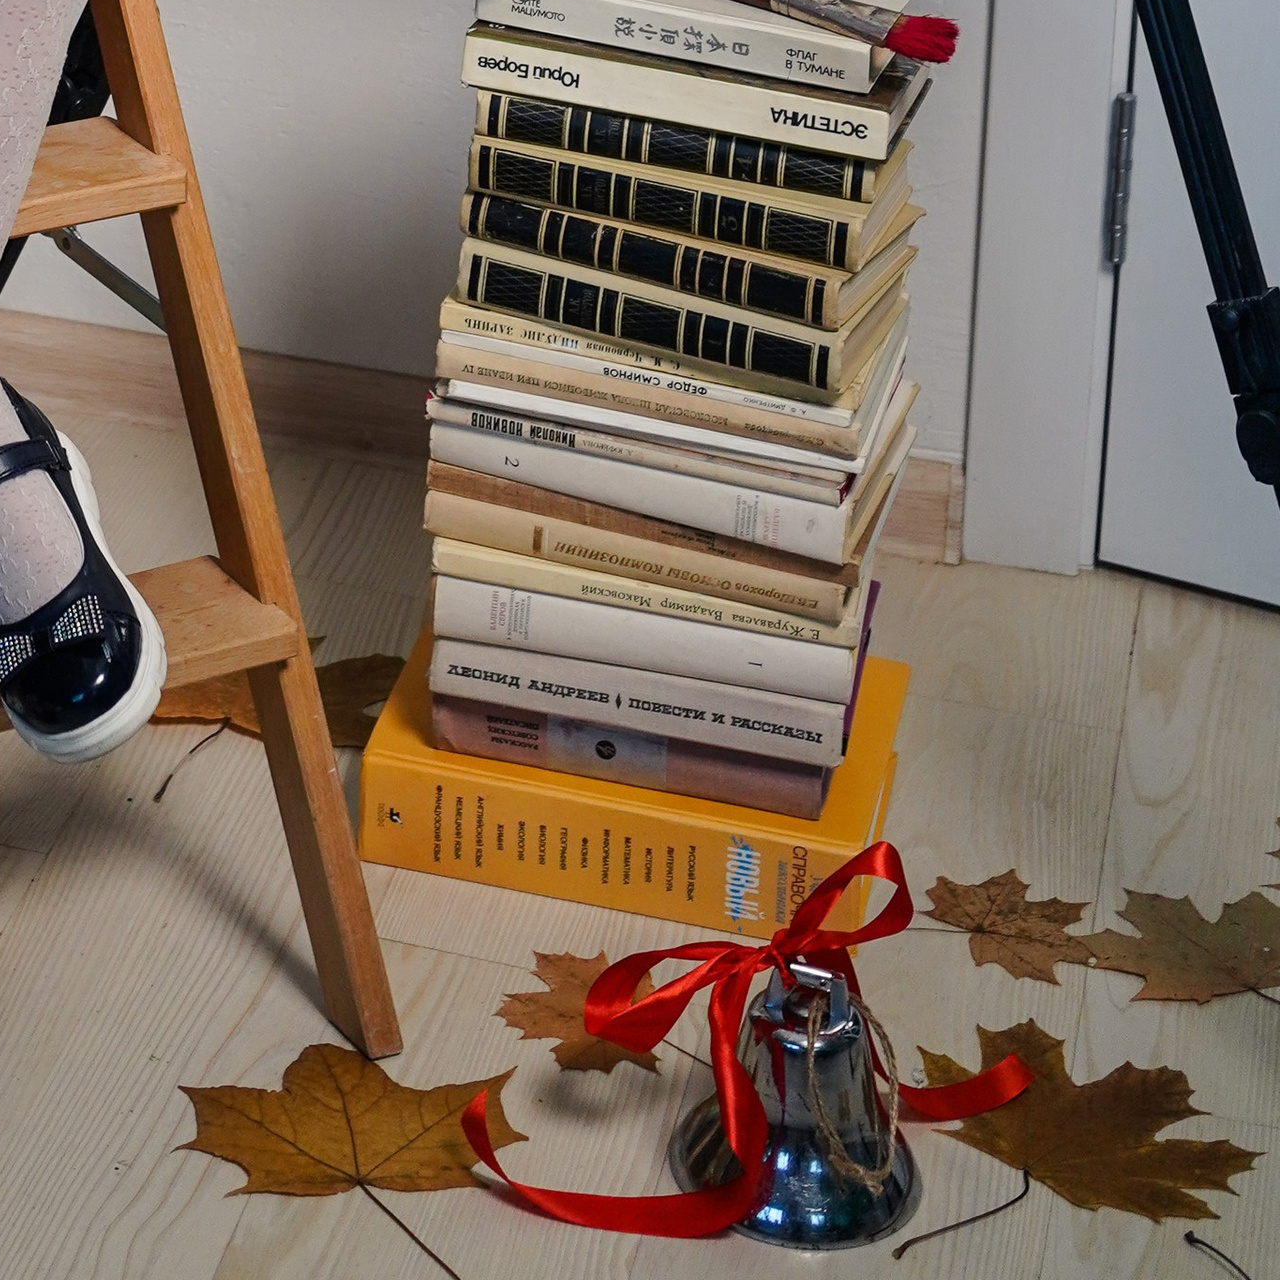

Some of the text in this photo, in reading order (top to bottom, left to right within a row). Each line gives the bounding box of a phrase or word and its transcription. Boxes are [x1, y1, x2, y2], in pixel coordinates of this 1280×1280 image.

[511, 5, 566, 22] МАЦУМОТО
[786, 48, 818, 61] ФЛАГ
[786, 60, 846, 80] В ТУМАНЕ
[477, 56, 868, 140] Юрий Борев ЭСТЕТИКА
[464, 318, 513, 337] ЗАРИНЬ
[520, 329, 579, 350] ИНДУЛИС
[586, 342, 643, 363] Червонная
[461, 364, 474, 374] IV
[477, 367, 514, 382] ИВАНЕ
[517, 373, 540, 386] ПРИ
[603, 366, 661, 386] СМИРНОВ
[544, 379, 608, 401] ЖИВОПИСИ
[667, 382, 707, 396] ФЕДОР
[471, 412, 523, 437] НОВИКОВ
[655, 402, 729, 426] МОСКОВСКАЯ
[530, 424, 576, 448] Николай
[504, 456, 520, 468] 2
[554, 541, 663, 576] КОМПОЗИЦИИ
[669, 567, 732, 590] ОСНОВЫ
[581, 585, 652, 607] Маковский
[660, 599, 723, 621] Владимир
[732, 614, 805, 639] Журавлева
[446, 664, 823, 744] ЛЕОНИД АНДРЕЕВ ПОВЕСТИ И РАССКАЗЫ
[433, 785, 443, 863] ФРАНЦУЗСКИЙ ЯЗЫК
[453, 796, 464, 861] НЕМЕЦКИЙ ЯЗЫК
[475, 795, 485, 868] АНГЛИЙСКИЙ ЯЗЫК
[496, 824, 505, 851] ХИМИЯ
[517, 820, 526, 861] ЭКОЛОГИЯ
[538, 824, 547, 865] БИОЛОГИЯ
[559, 827, 568, 871] ГЕОГРАФИЯ
[580, 837, 589, 869] ФИЗИКА
[602, 829, 611, 884] ИНФОРМАТИКА
[623, 836, 632, 885] МАТЕМАТИКА
[644, 847, 653, 883] ИСТОРИЯ
[687, 845, 696, 881] РУССКИЙ
[666, 845, 675, 892] ЛИТЕРАТУРА
[724, 846, 766, 921] НОВЫЙ
